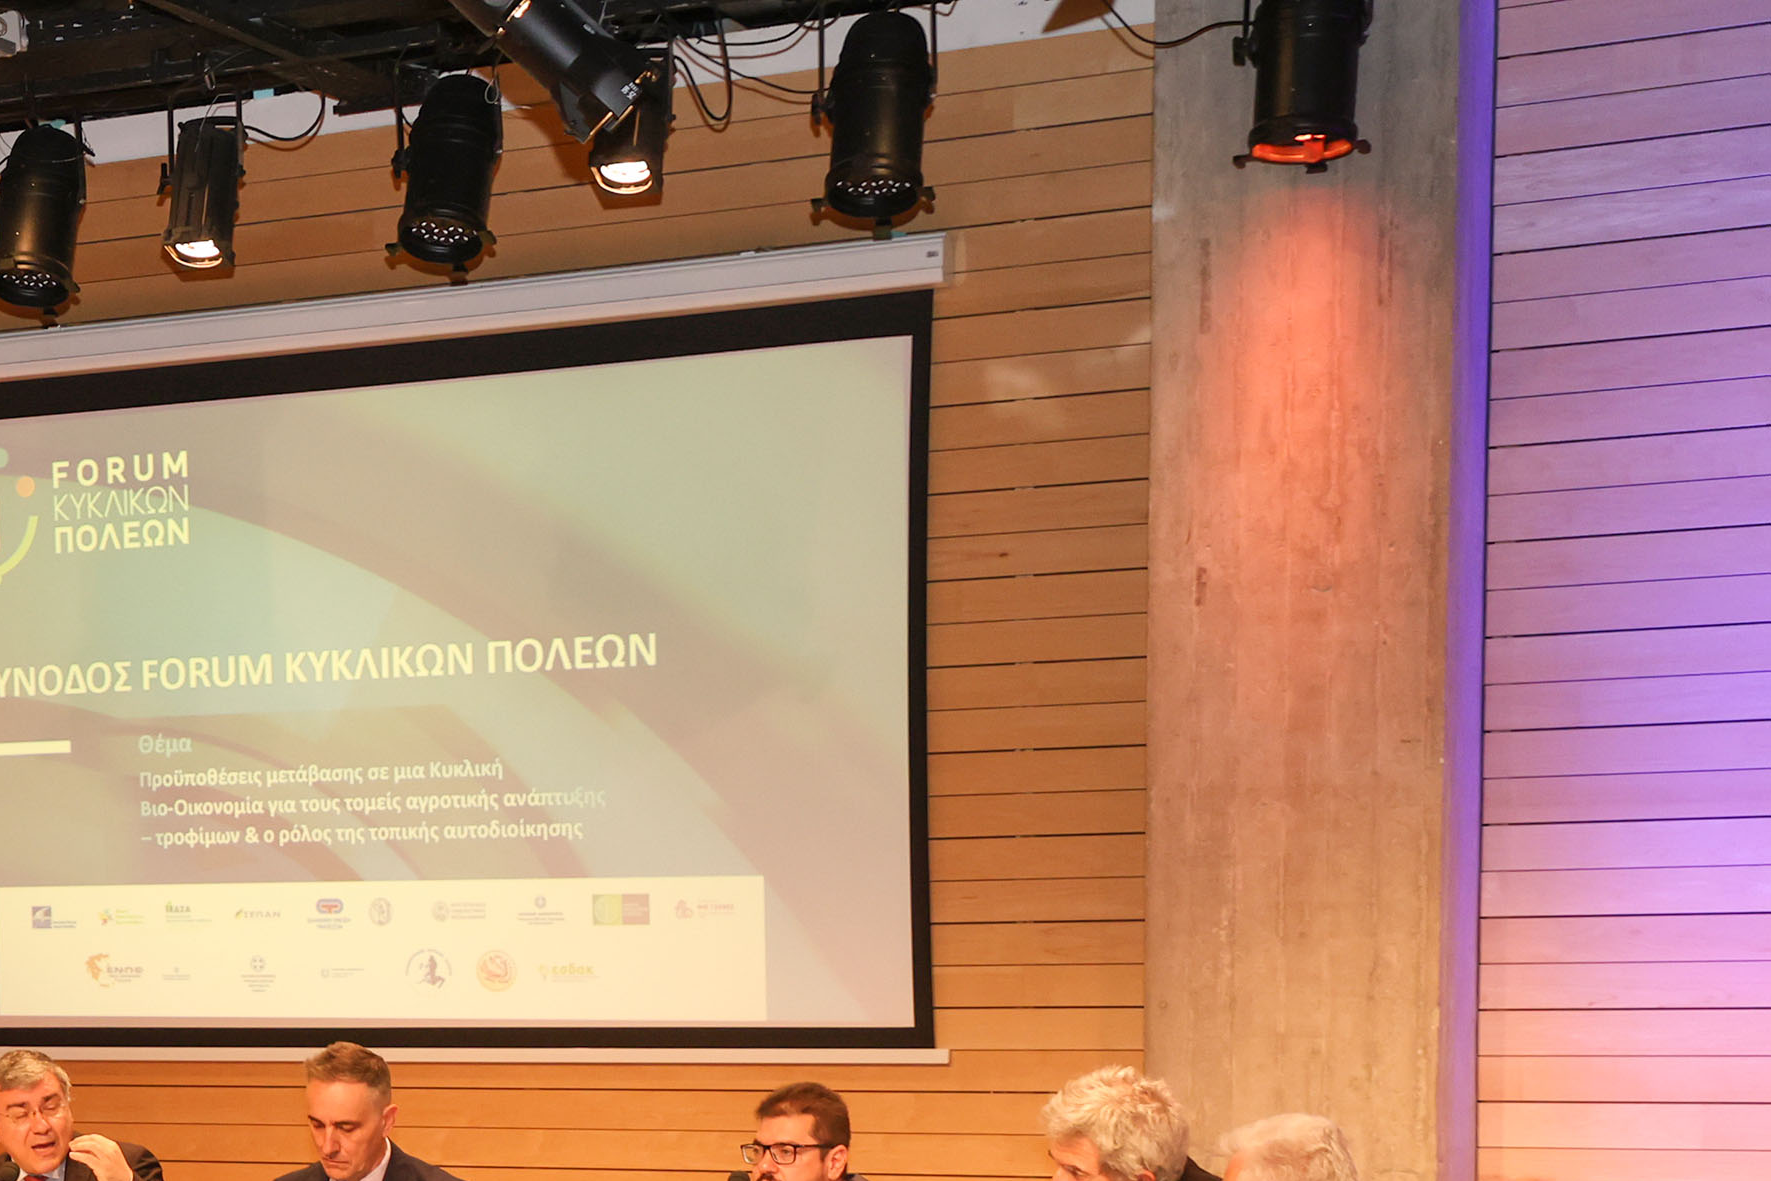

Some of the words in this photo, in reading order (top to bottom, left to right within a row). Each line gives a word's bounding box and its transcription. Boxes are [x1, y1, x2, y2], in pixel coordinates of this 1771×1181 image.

[52, 451, 188, 489] FORUM
[53, 484, 189, 521] ΚΥΚΛΙΚΩΝ
[54, 517, 190, 553] ΠΟΛΕΩΝ
[142, 653, 273, 690] FORUM
[286, 643, 473, 684] ΚΥΚΛΙΚΩΝ
[487, 632, 657, 674] ΠΟΛΕΩΝ
[138, 733, 192, 758] Θέμα
[140, 767, 262, 791] Προϋποθέσεις
[266, 764, 362, 786] μετάβασης
[368, 766, 389, 780] σε
[394, 765, 425, 783] μια
[429, 758, 503, 780] Κυκλική
[140, 796, 264, 818] Βιο-Οικονομία
[267, 798, 296, 817] για
[300, 798, 341, 815] τους
[344, 792, 401, 814] τομείς
[406, 788, 499, 813] αγροτικής
[503, 786, 606, 808] ανάπτυξης
[155, 825, 240, 849] τροφίμων
[244, 826, 259, 844] &
[263, 829, 275, 843] ο
[279, 824, 332, 846] ρόλος
[336, 827, 365, 844] της
[368, 821, 439, 843] τοπικής
[443, 818, 584, 840] αυτοδιοίκησης
